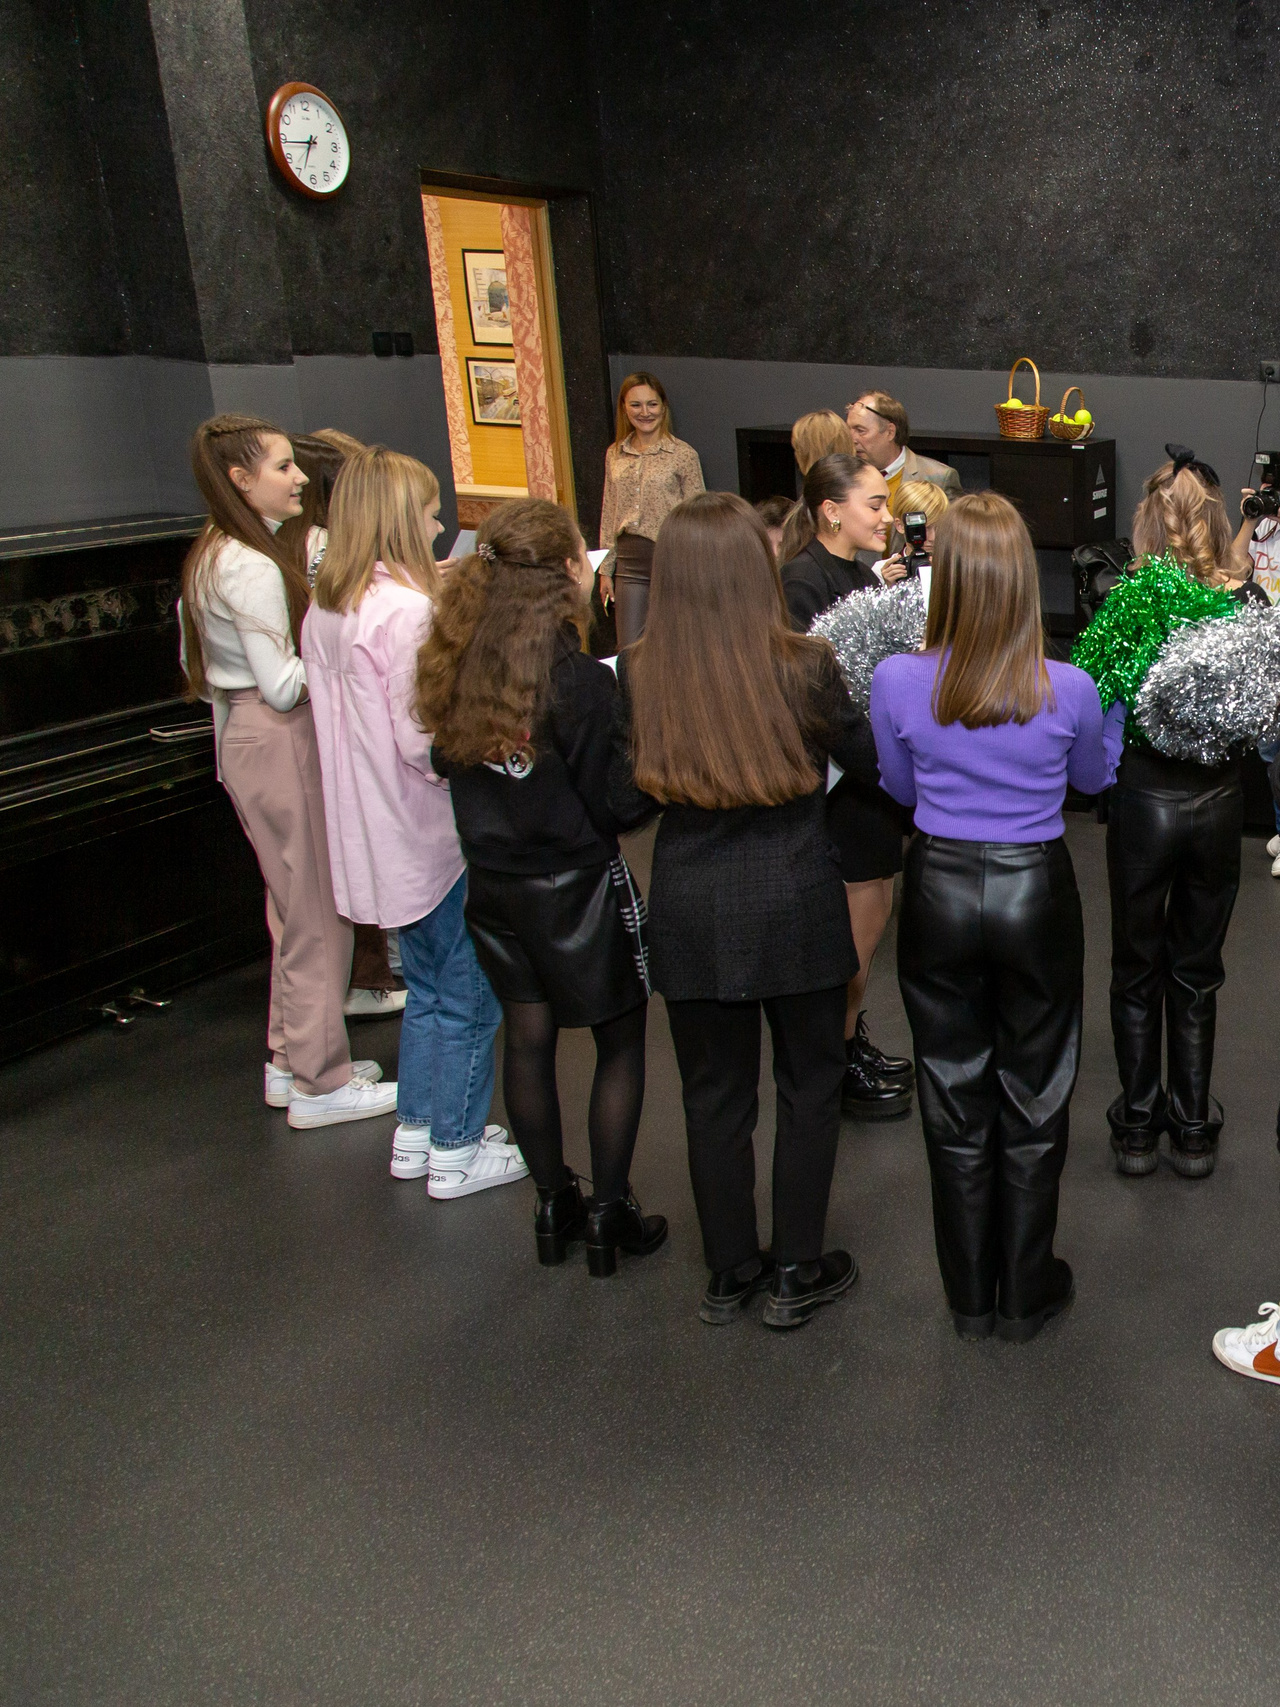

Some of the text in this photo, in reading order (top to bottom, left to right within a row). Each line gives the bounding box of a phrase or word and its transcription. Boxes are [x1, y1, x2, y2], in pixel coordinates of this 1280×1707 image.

[288, 103, 296, 115] 11
[300, 100, 310, 112] 12
[325, 122, 334, 134] 2
[280, 132, 288, 144] 9
[331, 141, 339, 153] 3
[285, 152, 294, 164] 8
[329, 160, 337, 170] 4
[295, 167, 302, 178] 7
[322, 171, 331, 182] 5
[309, 174, 318, 185] 6
